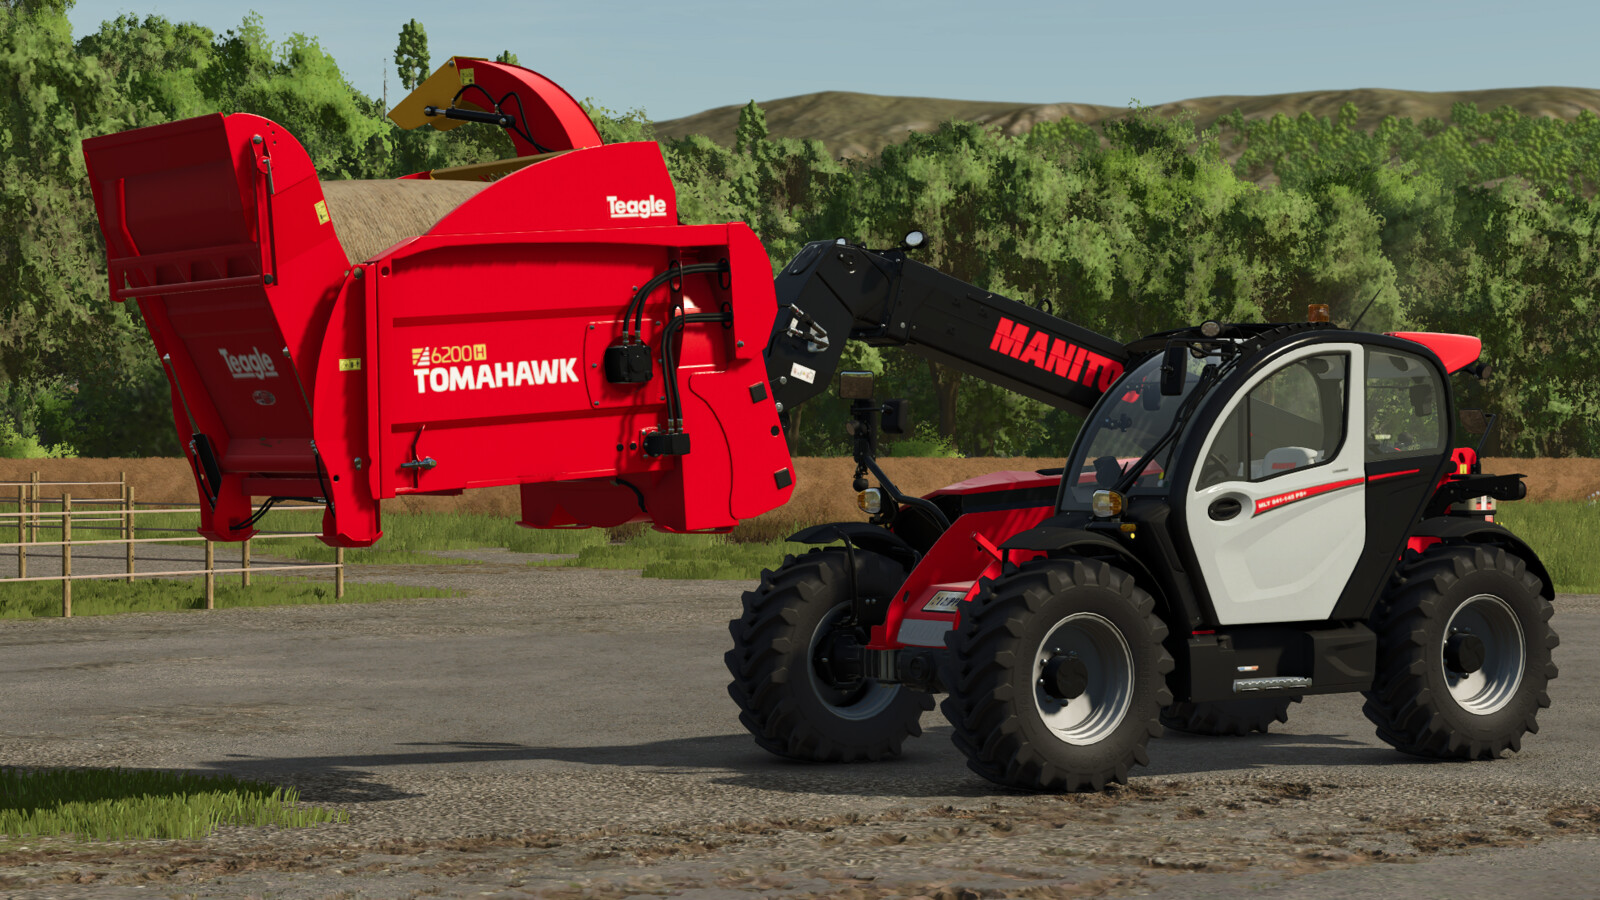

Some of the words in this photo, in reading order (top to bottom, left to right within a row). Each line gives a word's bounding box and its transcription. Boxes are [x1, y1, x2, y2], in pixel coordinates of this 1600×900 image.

[606, 194, 667, 219] Teagle
[218, 346, 278, 380] Teagle
[431, 345, 472, 364] 6200
[989, 316, 1126, 395] MANITO
[413, 357, 579, 394] TOMAHAWK
